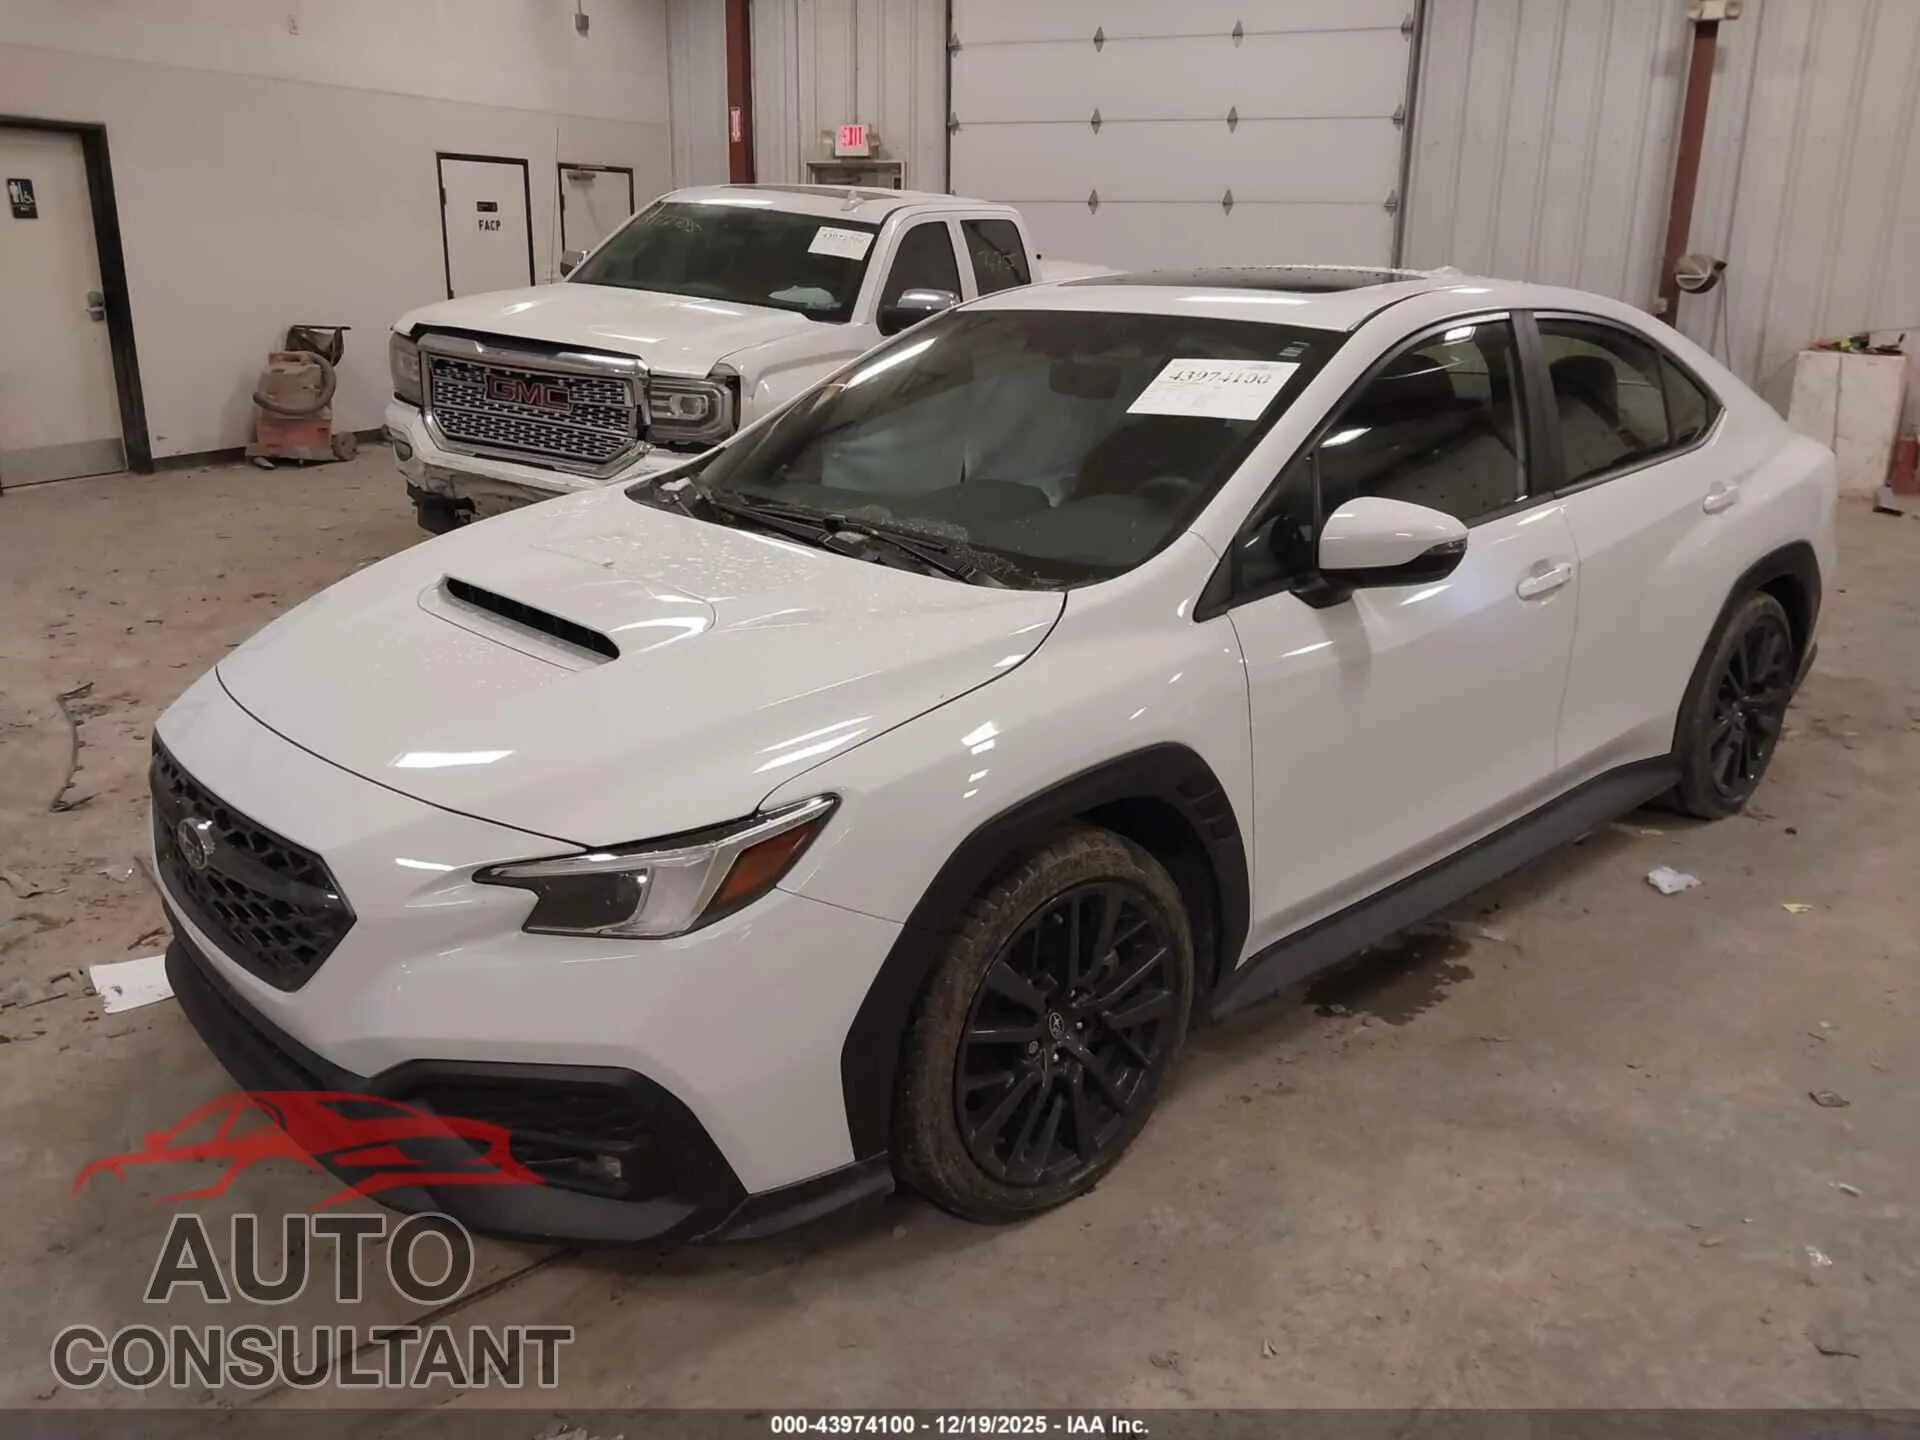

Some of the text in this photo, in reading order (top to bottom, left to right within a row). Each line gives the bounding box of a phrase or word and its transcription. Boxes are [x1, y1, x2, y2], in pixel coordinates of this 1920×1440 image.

[478, 219, 501, 231] FACP
[1169, 370, 1271, 385] 43974100
[485, 375, 570, 412] GMC
